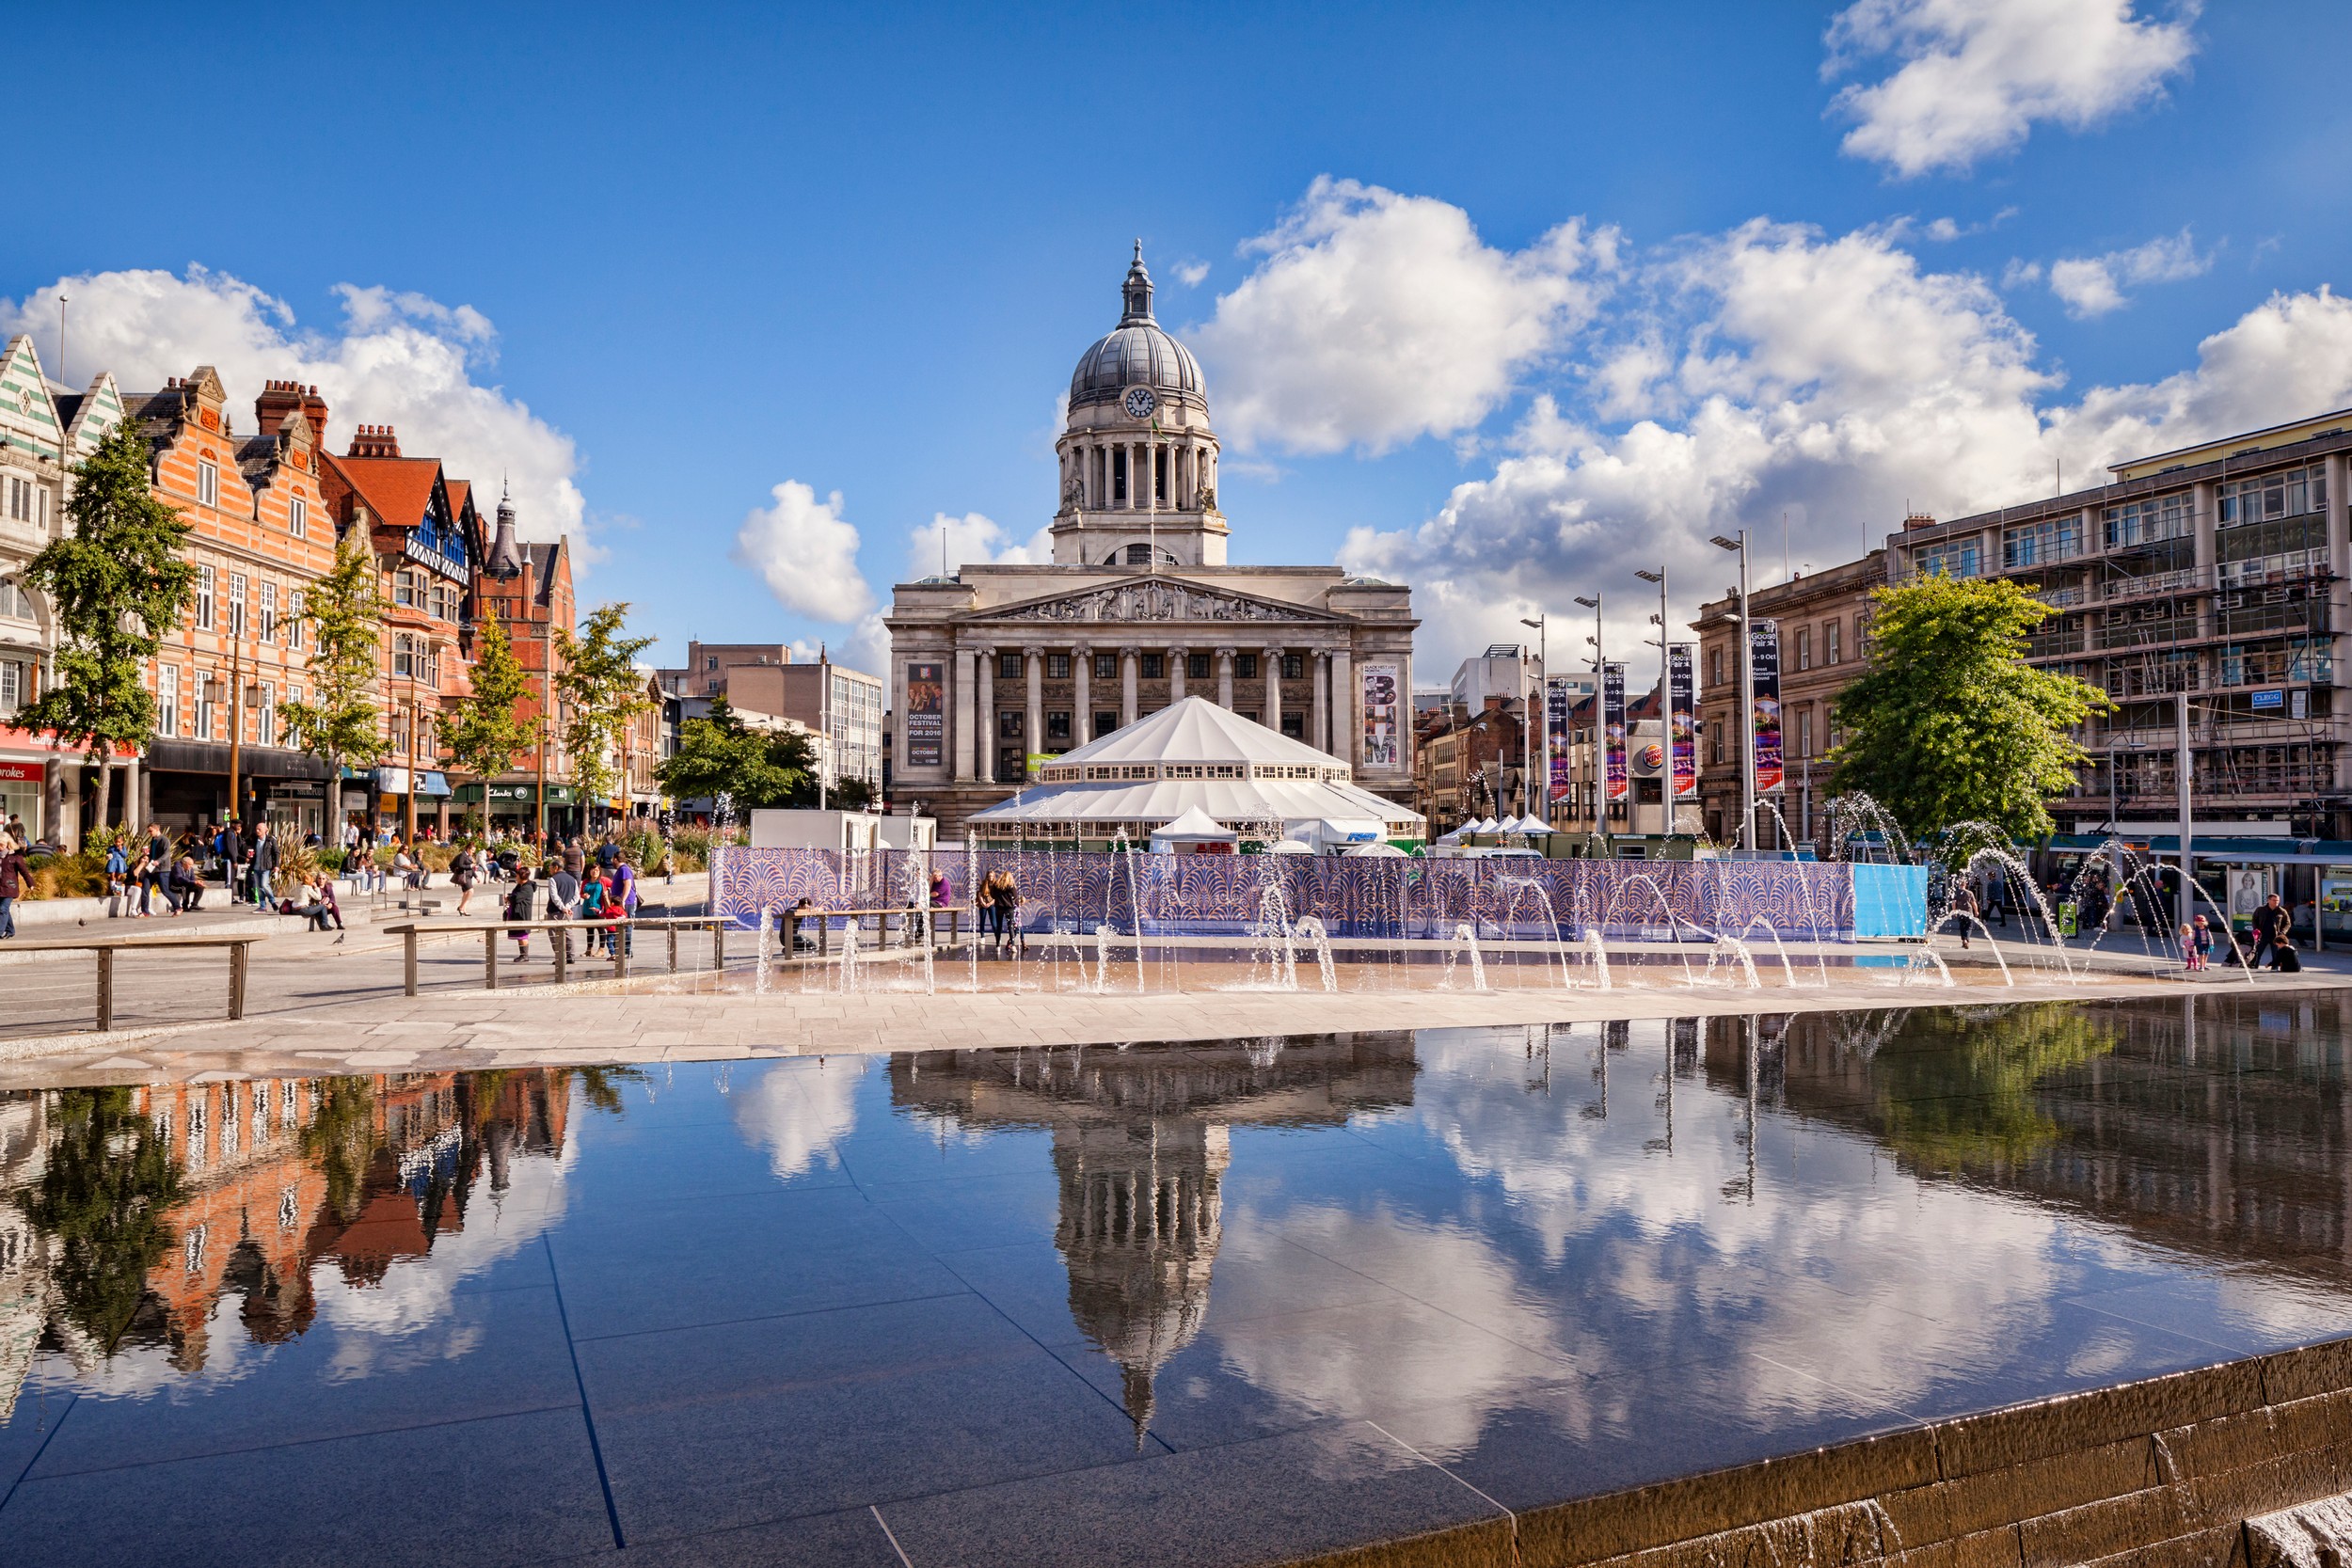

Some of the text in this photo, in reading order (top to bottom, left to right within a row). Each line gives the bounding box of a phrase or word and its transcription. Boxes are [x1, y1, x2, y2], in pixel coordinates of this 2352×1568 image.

[1364, 675, 1397, 705] B
[2254, 693, 2280, 702] CLEGG
[1364, 705, 1397, 735] H
[1364, 735, 1397, 764] M
